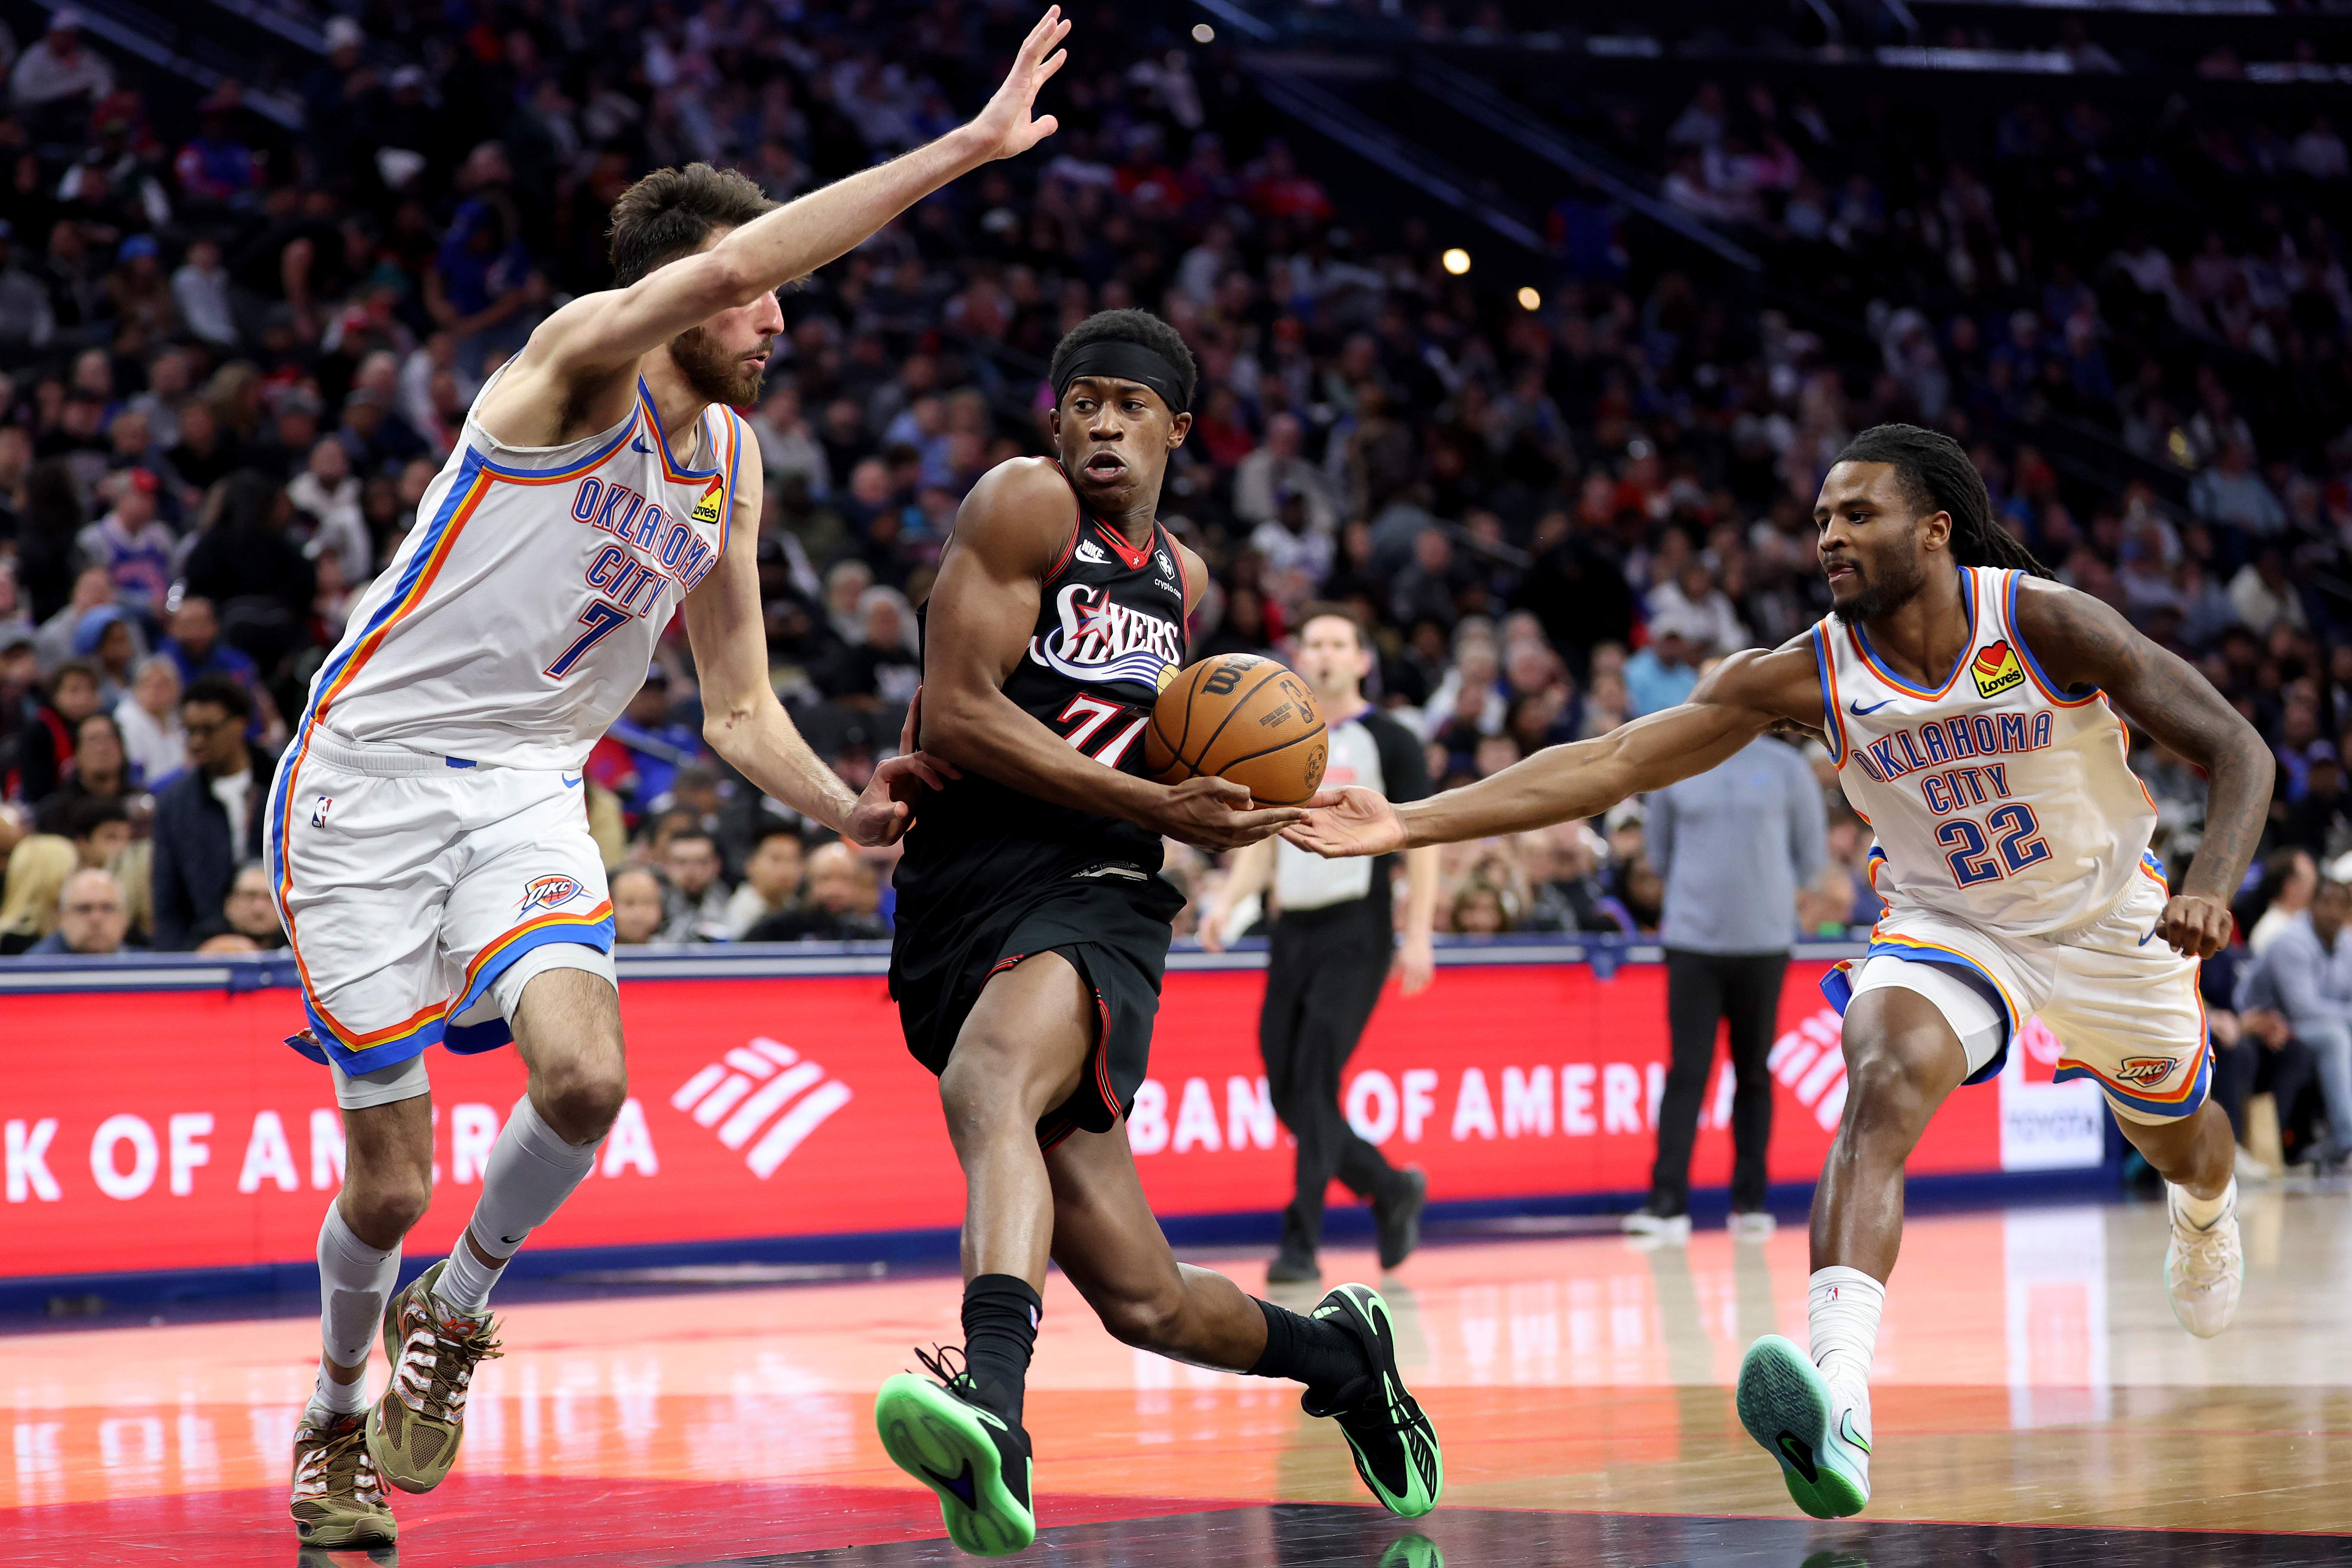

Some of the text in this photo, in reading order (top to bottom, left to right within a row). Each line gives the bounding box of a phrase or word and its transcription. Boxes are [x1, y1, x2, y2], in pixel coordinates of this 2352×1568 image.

[571, 476, 717, 596] OKLAHOMA
[1081, 539, 1104, 559] NIKE
[585, 545, 671, 618] CITY
[1155, 578, 1182, 600] crypto.com
[543, 598, 634, 680] 7
[1850, 710, 2054, 782] OKLAHOMA
[1921, 762, 2011, 816] CITY
[1934, 802, 2054, 890] 22
[1127, 1074, 1299, 1155] BAN
[1346, 1067, 1440, 1145] OF
[89, 1113, 215, 1200] OF
